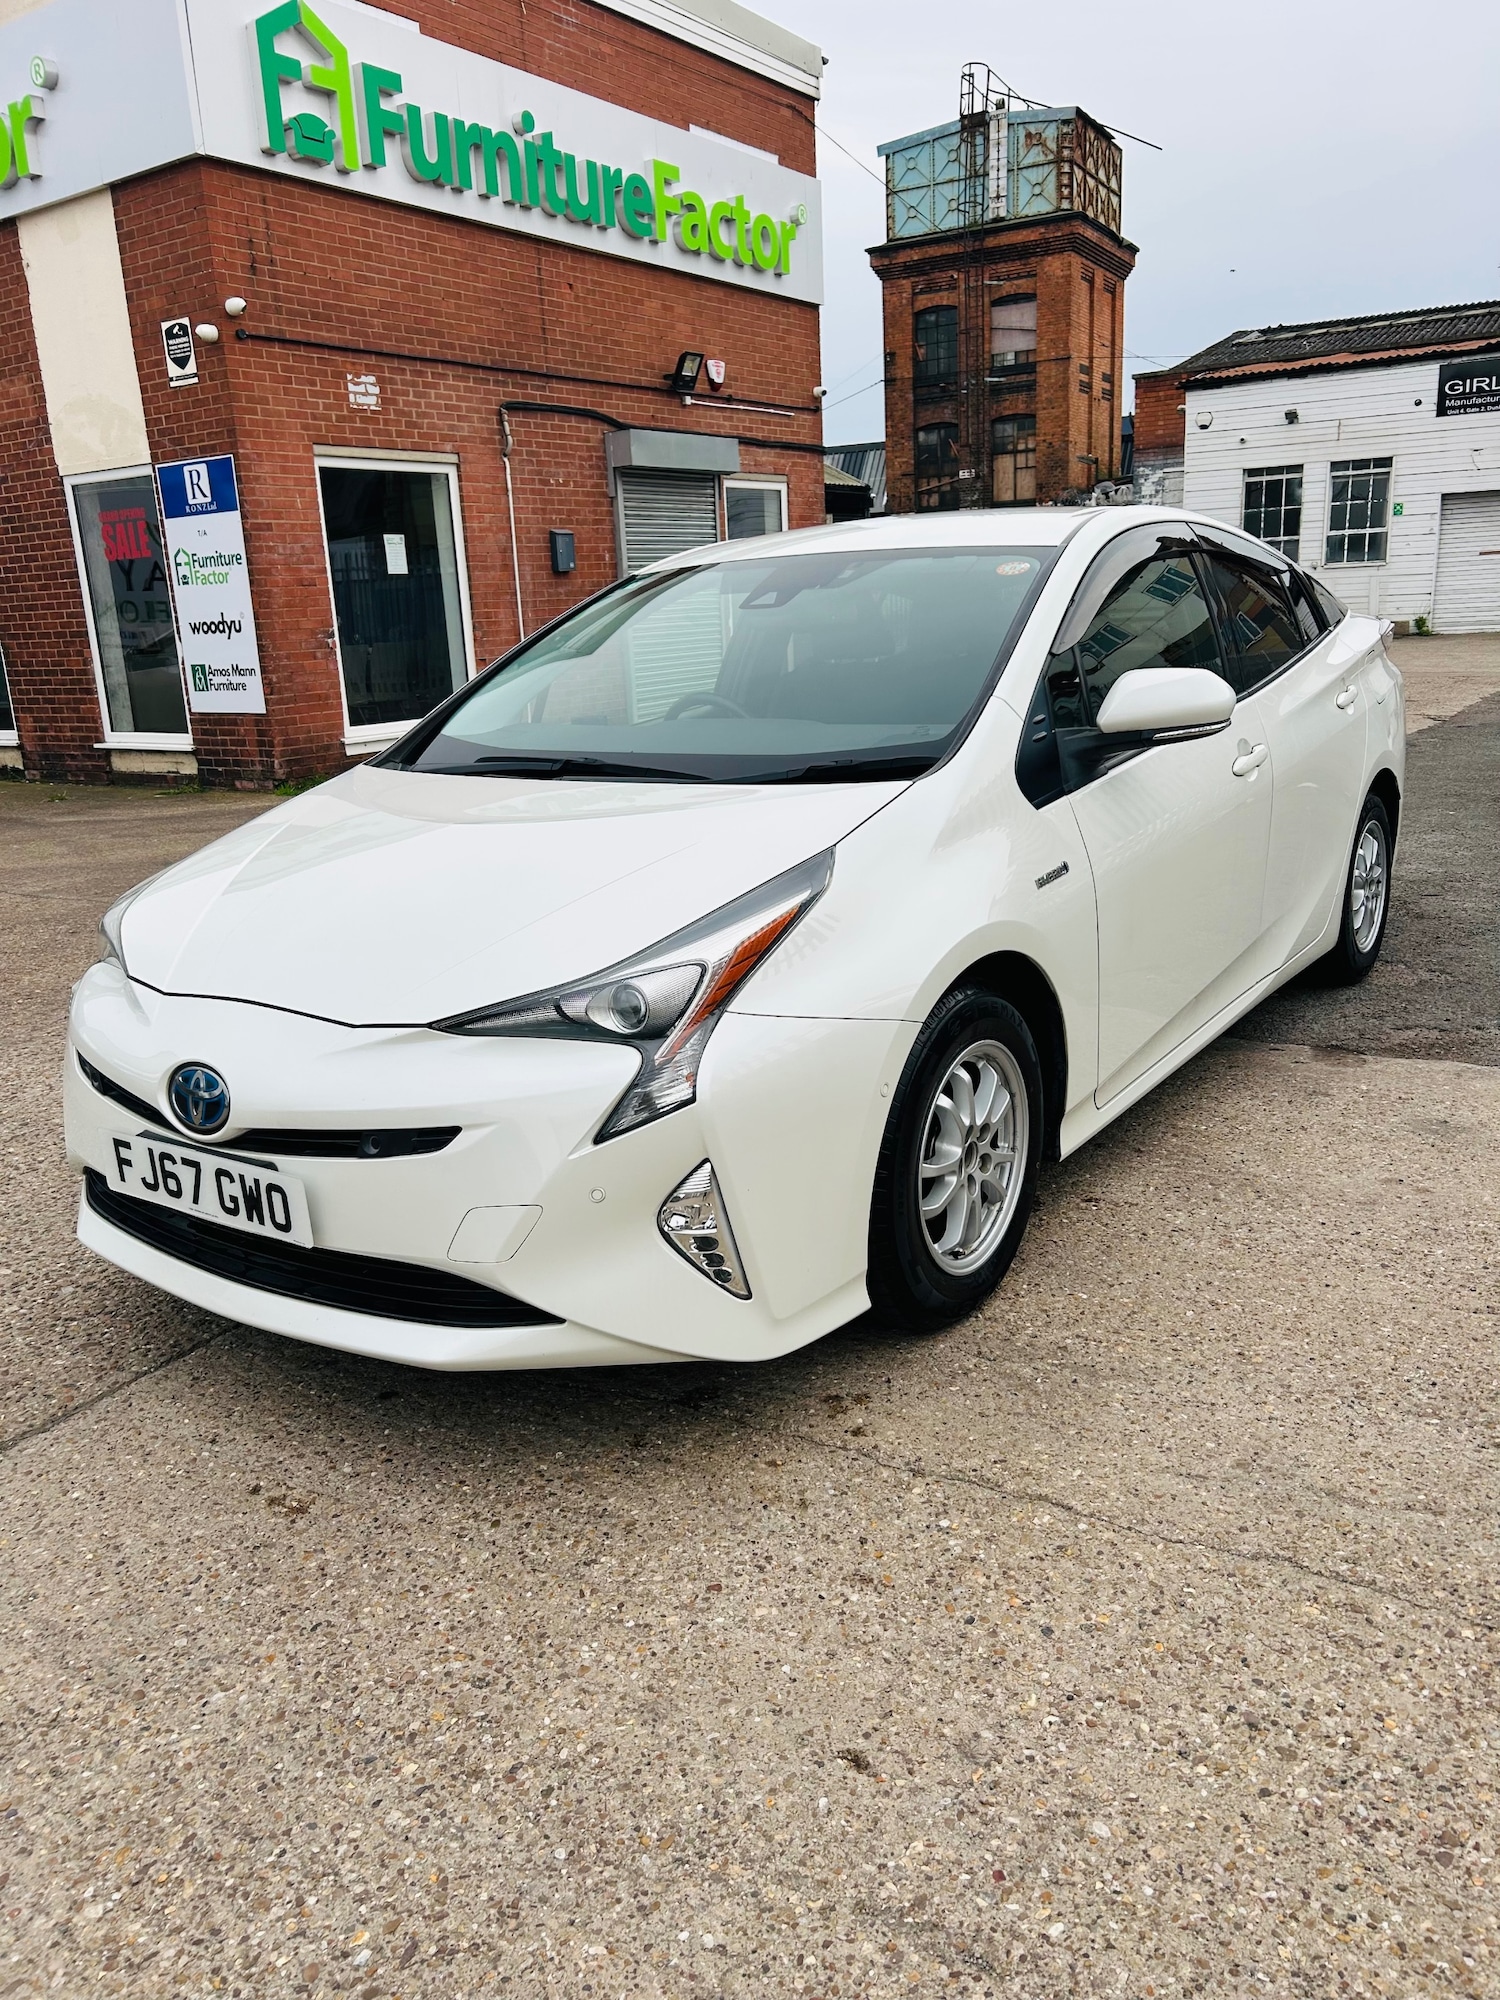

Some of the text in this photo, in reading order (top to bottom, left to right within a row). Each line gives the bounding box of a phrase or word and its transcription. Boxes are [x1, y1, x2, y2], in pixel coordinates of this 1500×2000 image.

[168, 335, 189, 346] WARNING
[101, 520, 152, 562] SALE
[191, 550, 243, 569] Furniture
[194, 570, 230, 586] Factor
[188, 612, 242, 640] woodyu
[207, 663, 257, 677] Amos Mann
[208, 678, 247, 691] Furniture
[112, 1137, 292, 1233] FJ67 GWO
